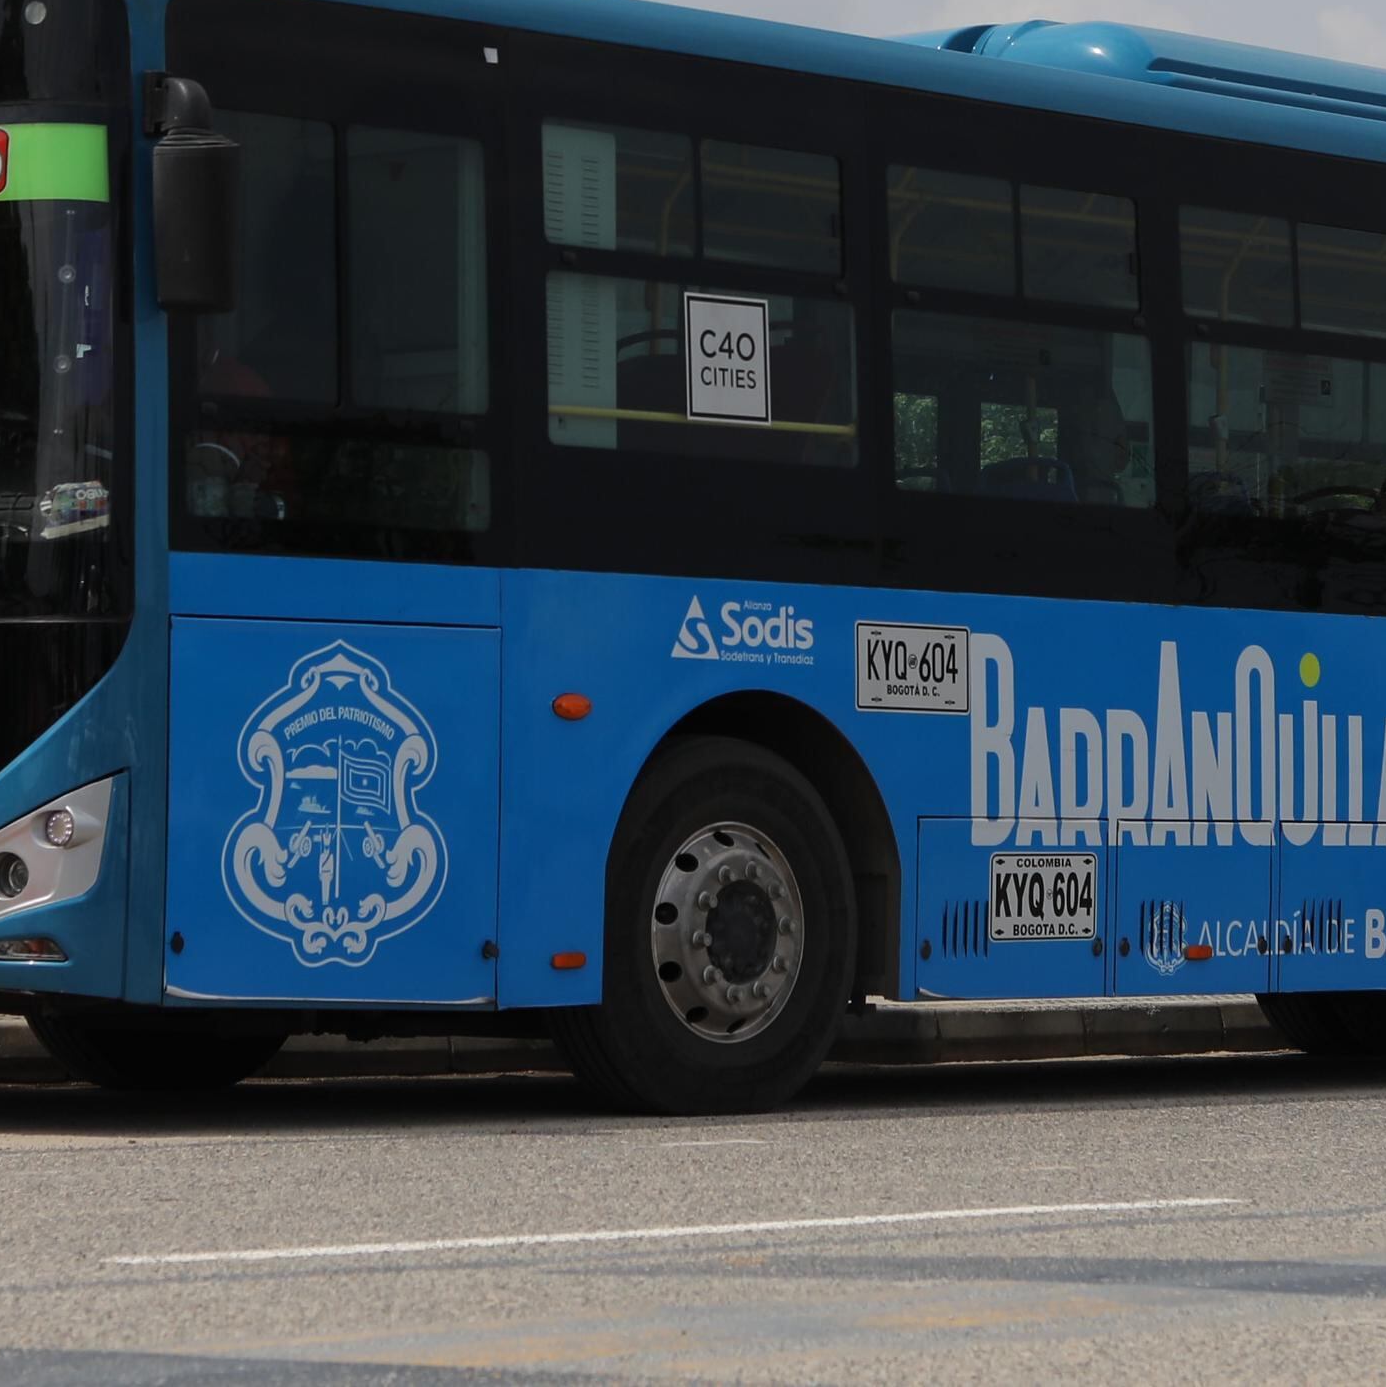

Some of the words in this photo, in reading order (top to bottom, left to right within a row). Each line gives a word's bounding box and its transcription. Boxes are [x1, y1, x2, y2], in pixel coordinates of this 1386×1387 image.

[700, 329, 755, 361] C40
[700, 366, 757, 389] CITIES
[742, 600, 772, 611] Alianza
[720, 601, 814, 650] Sodis
[720, 650, 764, 663] Sodetrans
[766, 655, 771, 665] y
[866, 639, 907, 681] KYQ
[918, 642, 958, 684] 604
[283, 711, 319, 741] PREMIO
[319, 706, 337, 722] DEL
[338, 705, 396, 741] PATRIOTISMO
[1016, 858, 1072, 868] COLOMBIA
[995, 872, 1045, 921] KYQ
[1053, 871, 1093, 918] 604
[1013, 923, 1056, 936] BOGOTA
[1058, 923, 1078, 936] D.C.
[1325, 918, 1356, 955] DE
